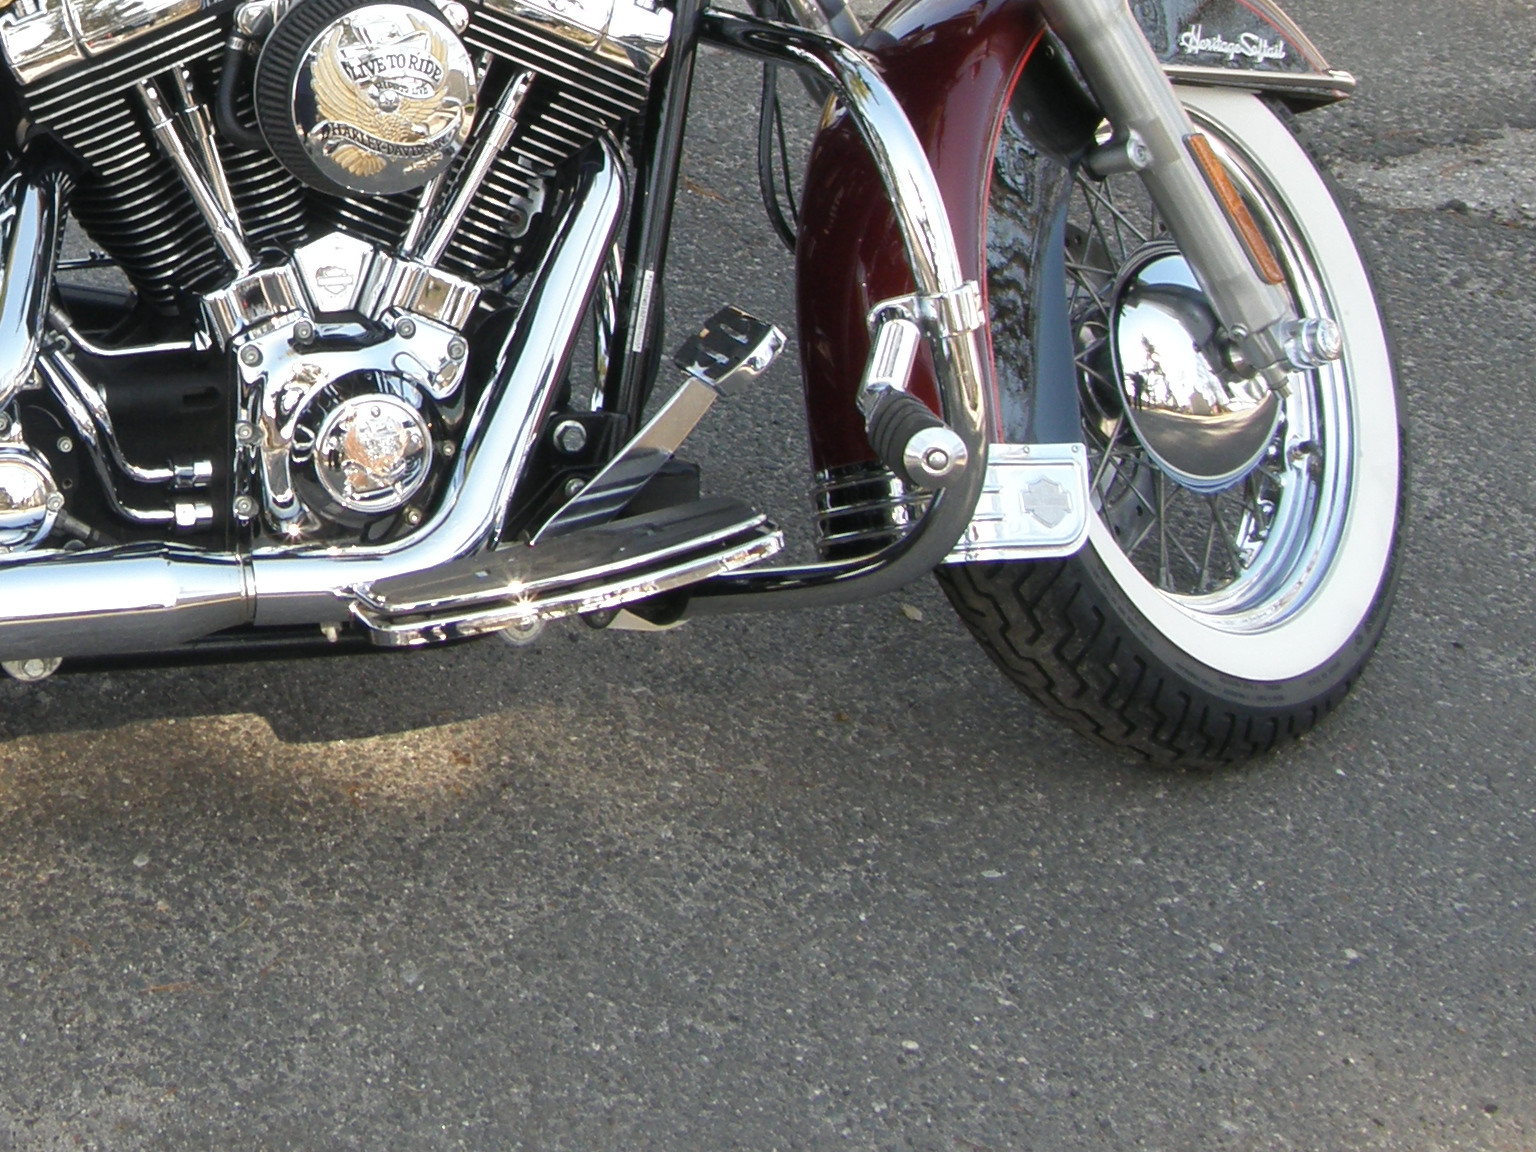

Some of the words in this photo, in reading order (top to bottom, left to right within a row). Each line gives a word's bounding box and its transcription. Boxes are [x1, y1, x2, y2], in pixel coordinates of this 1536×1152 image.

[351, 57, 387, 83] LIVE
[386, 54, 406, 70] TO
[408, 54, 442, 85] RIDE
